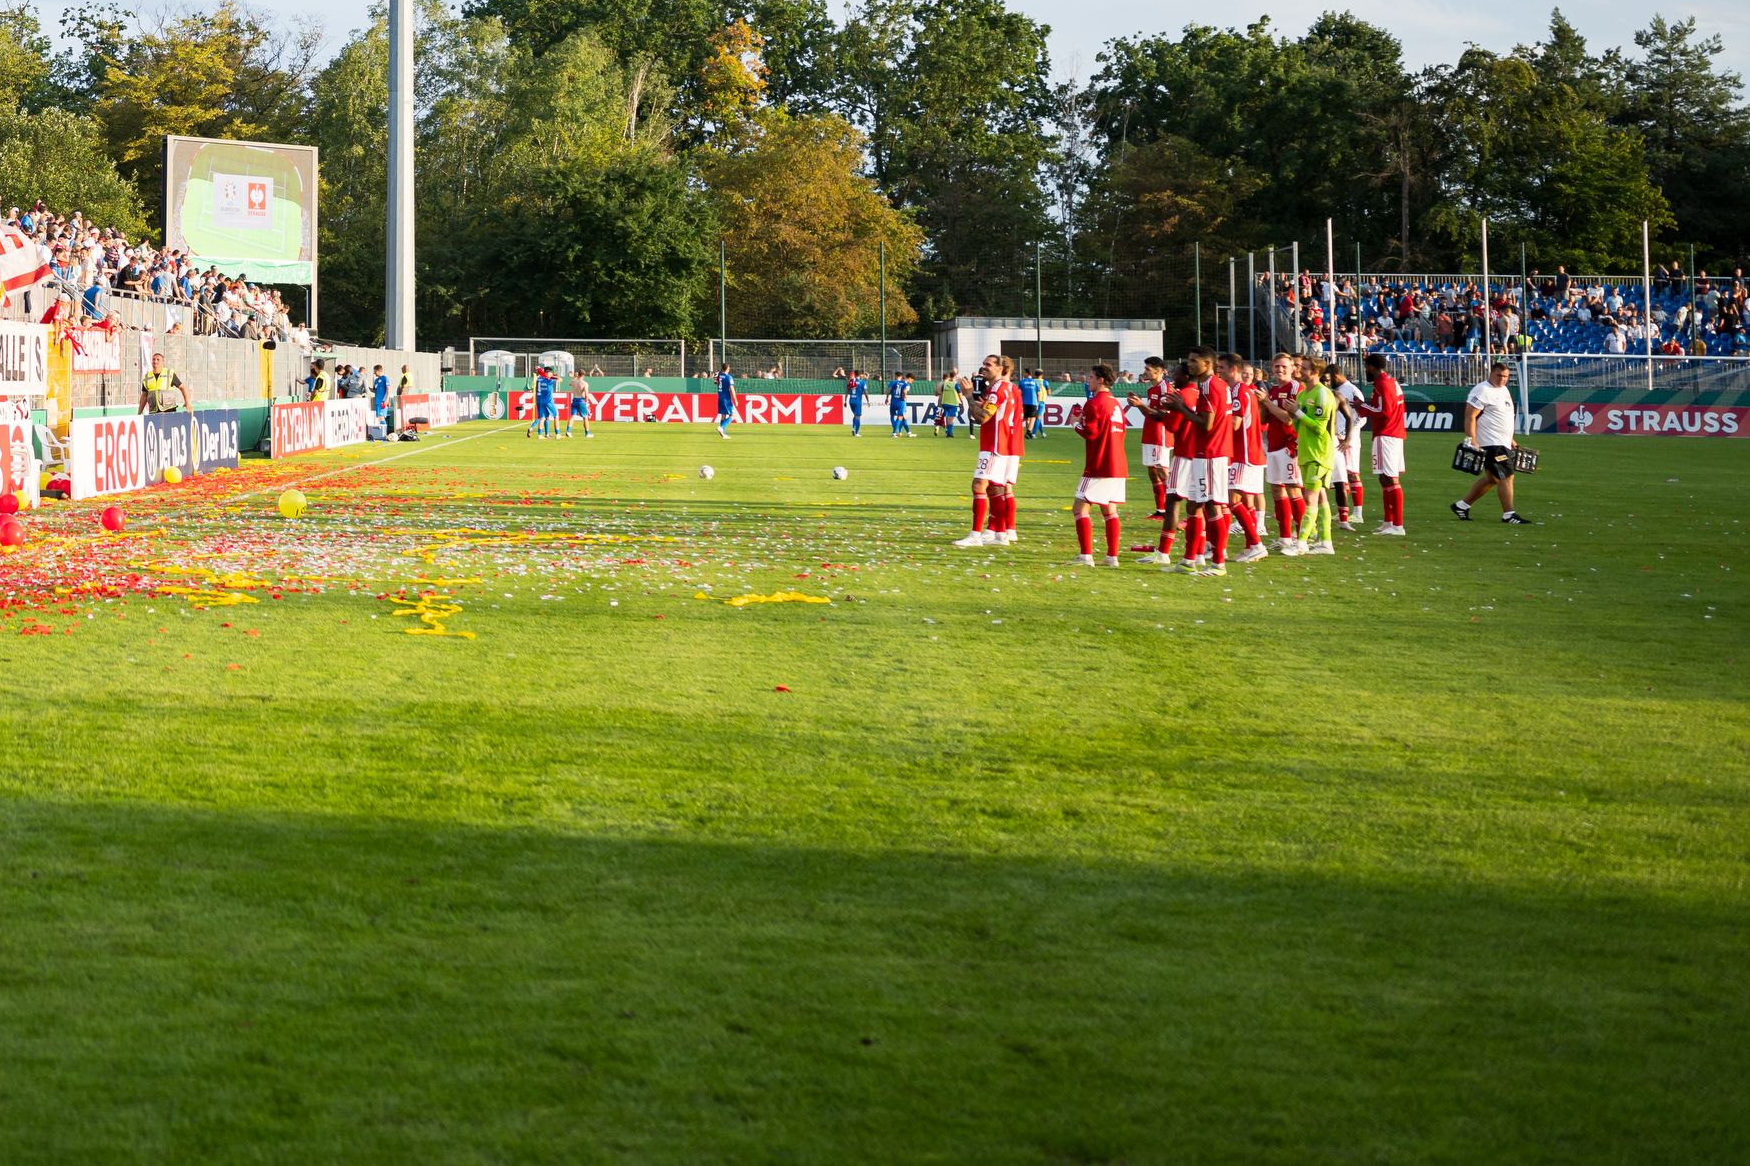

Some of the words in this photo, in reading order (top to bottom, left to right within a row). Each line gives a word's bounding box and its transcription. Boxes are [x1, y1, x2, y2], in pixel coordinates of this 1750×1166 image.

[1607, 408, 1739, 434] STRAUSS
[94, 420, 139, 492] ERGO
[158, 429, 171, 470] Der
[171, 424, 187, 467] ID.3
[202, 423, 219, 462] Der
[220, 420, 238, 460] ID.3
[1199, 477, 1207, 493] 5
[1286, 463, 1294, 477] 9
